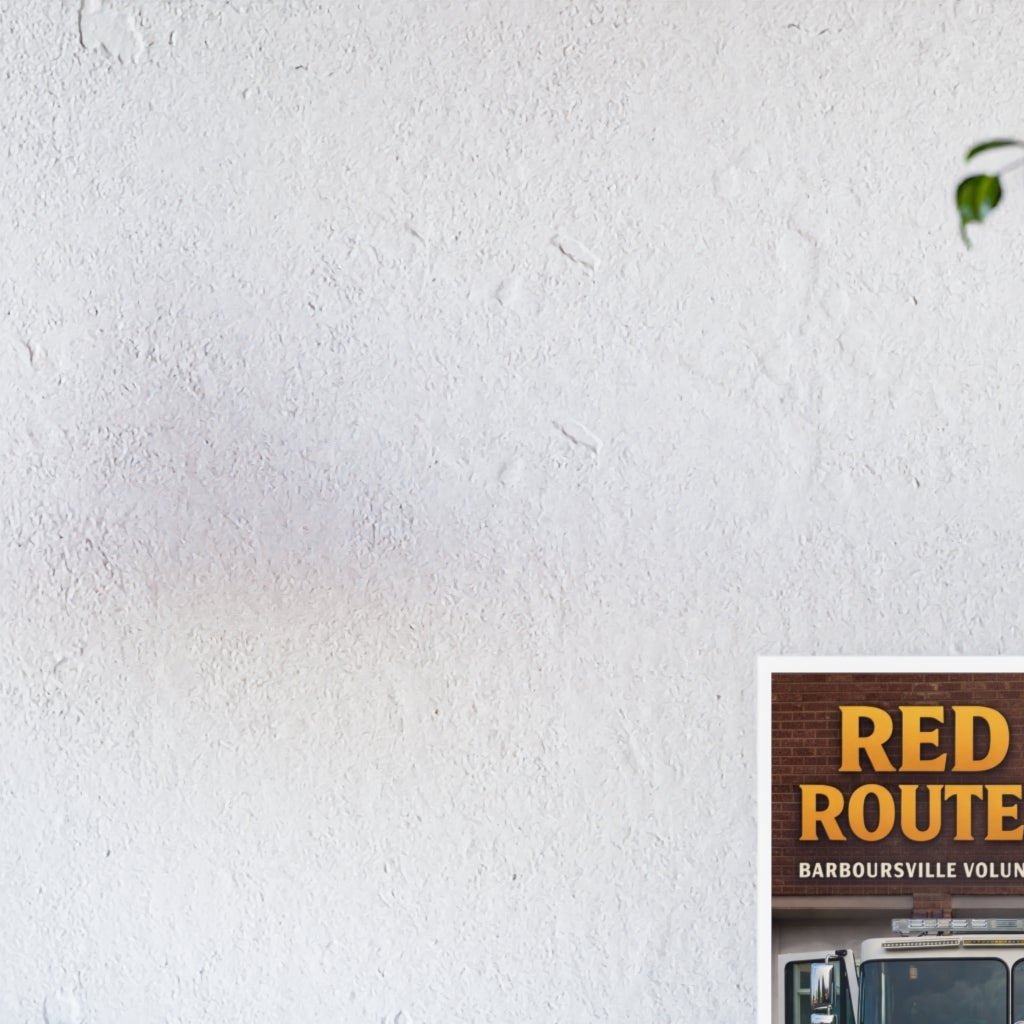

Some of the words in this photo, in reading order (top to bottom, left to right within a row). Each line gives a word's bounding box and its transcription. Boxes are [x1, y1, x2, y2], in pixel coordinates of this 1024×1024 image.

[838, 705, 1010, 773] RED
[799, 784, 1024, 841] ROUTE
[799, 861, 957, 879] BARBOURSVILLE
